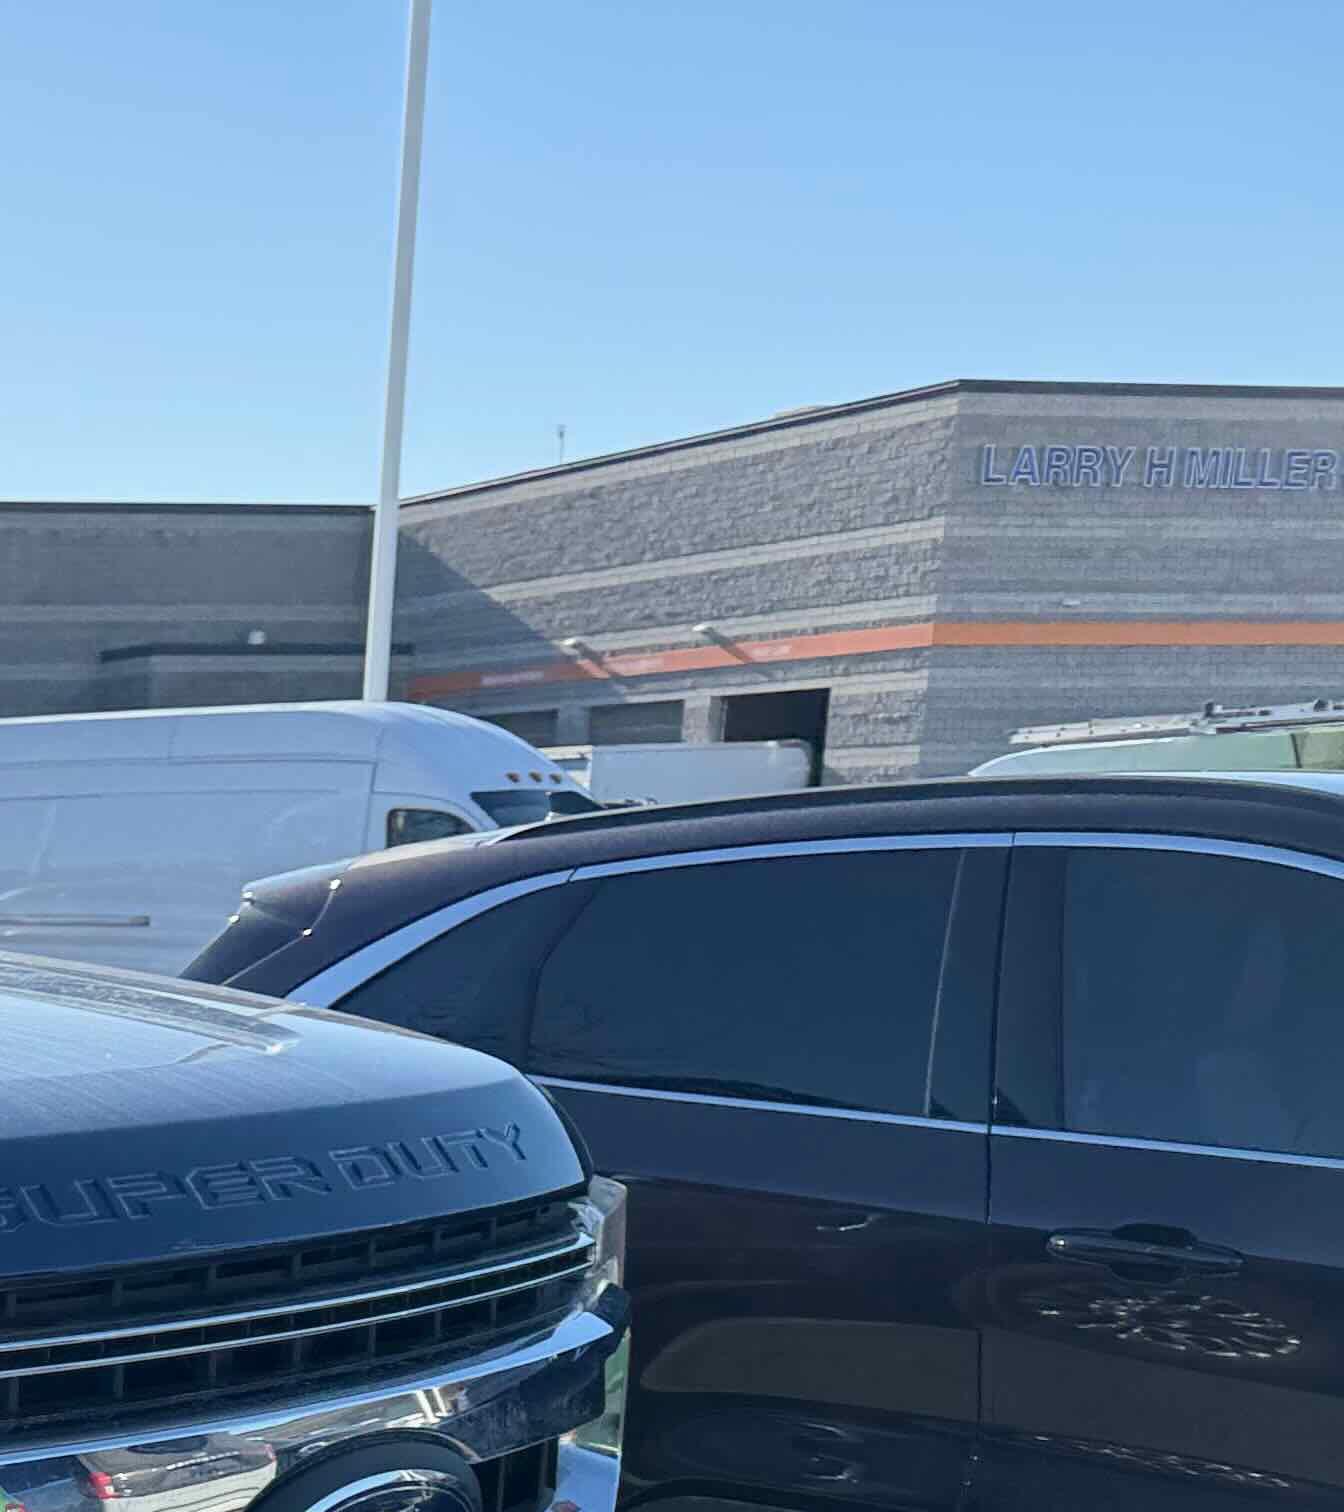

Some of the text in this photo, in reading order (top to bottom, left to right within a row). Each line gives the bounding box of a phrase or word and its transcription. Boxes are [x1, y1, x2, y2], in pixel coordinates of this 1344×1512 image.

[980, 443, 1339, 491] LARRY H MILLER
[328, 1121, 529, 1191] DUTY
